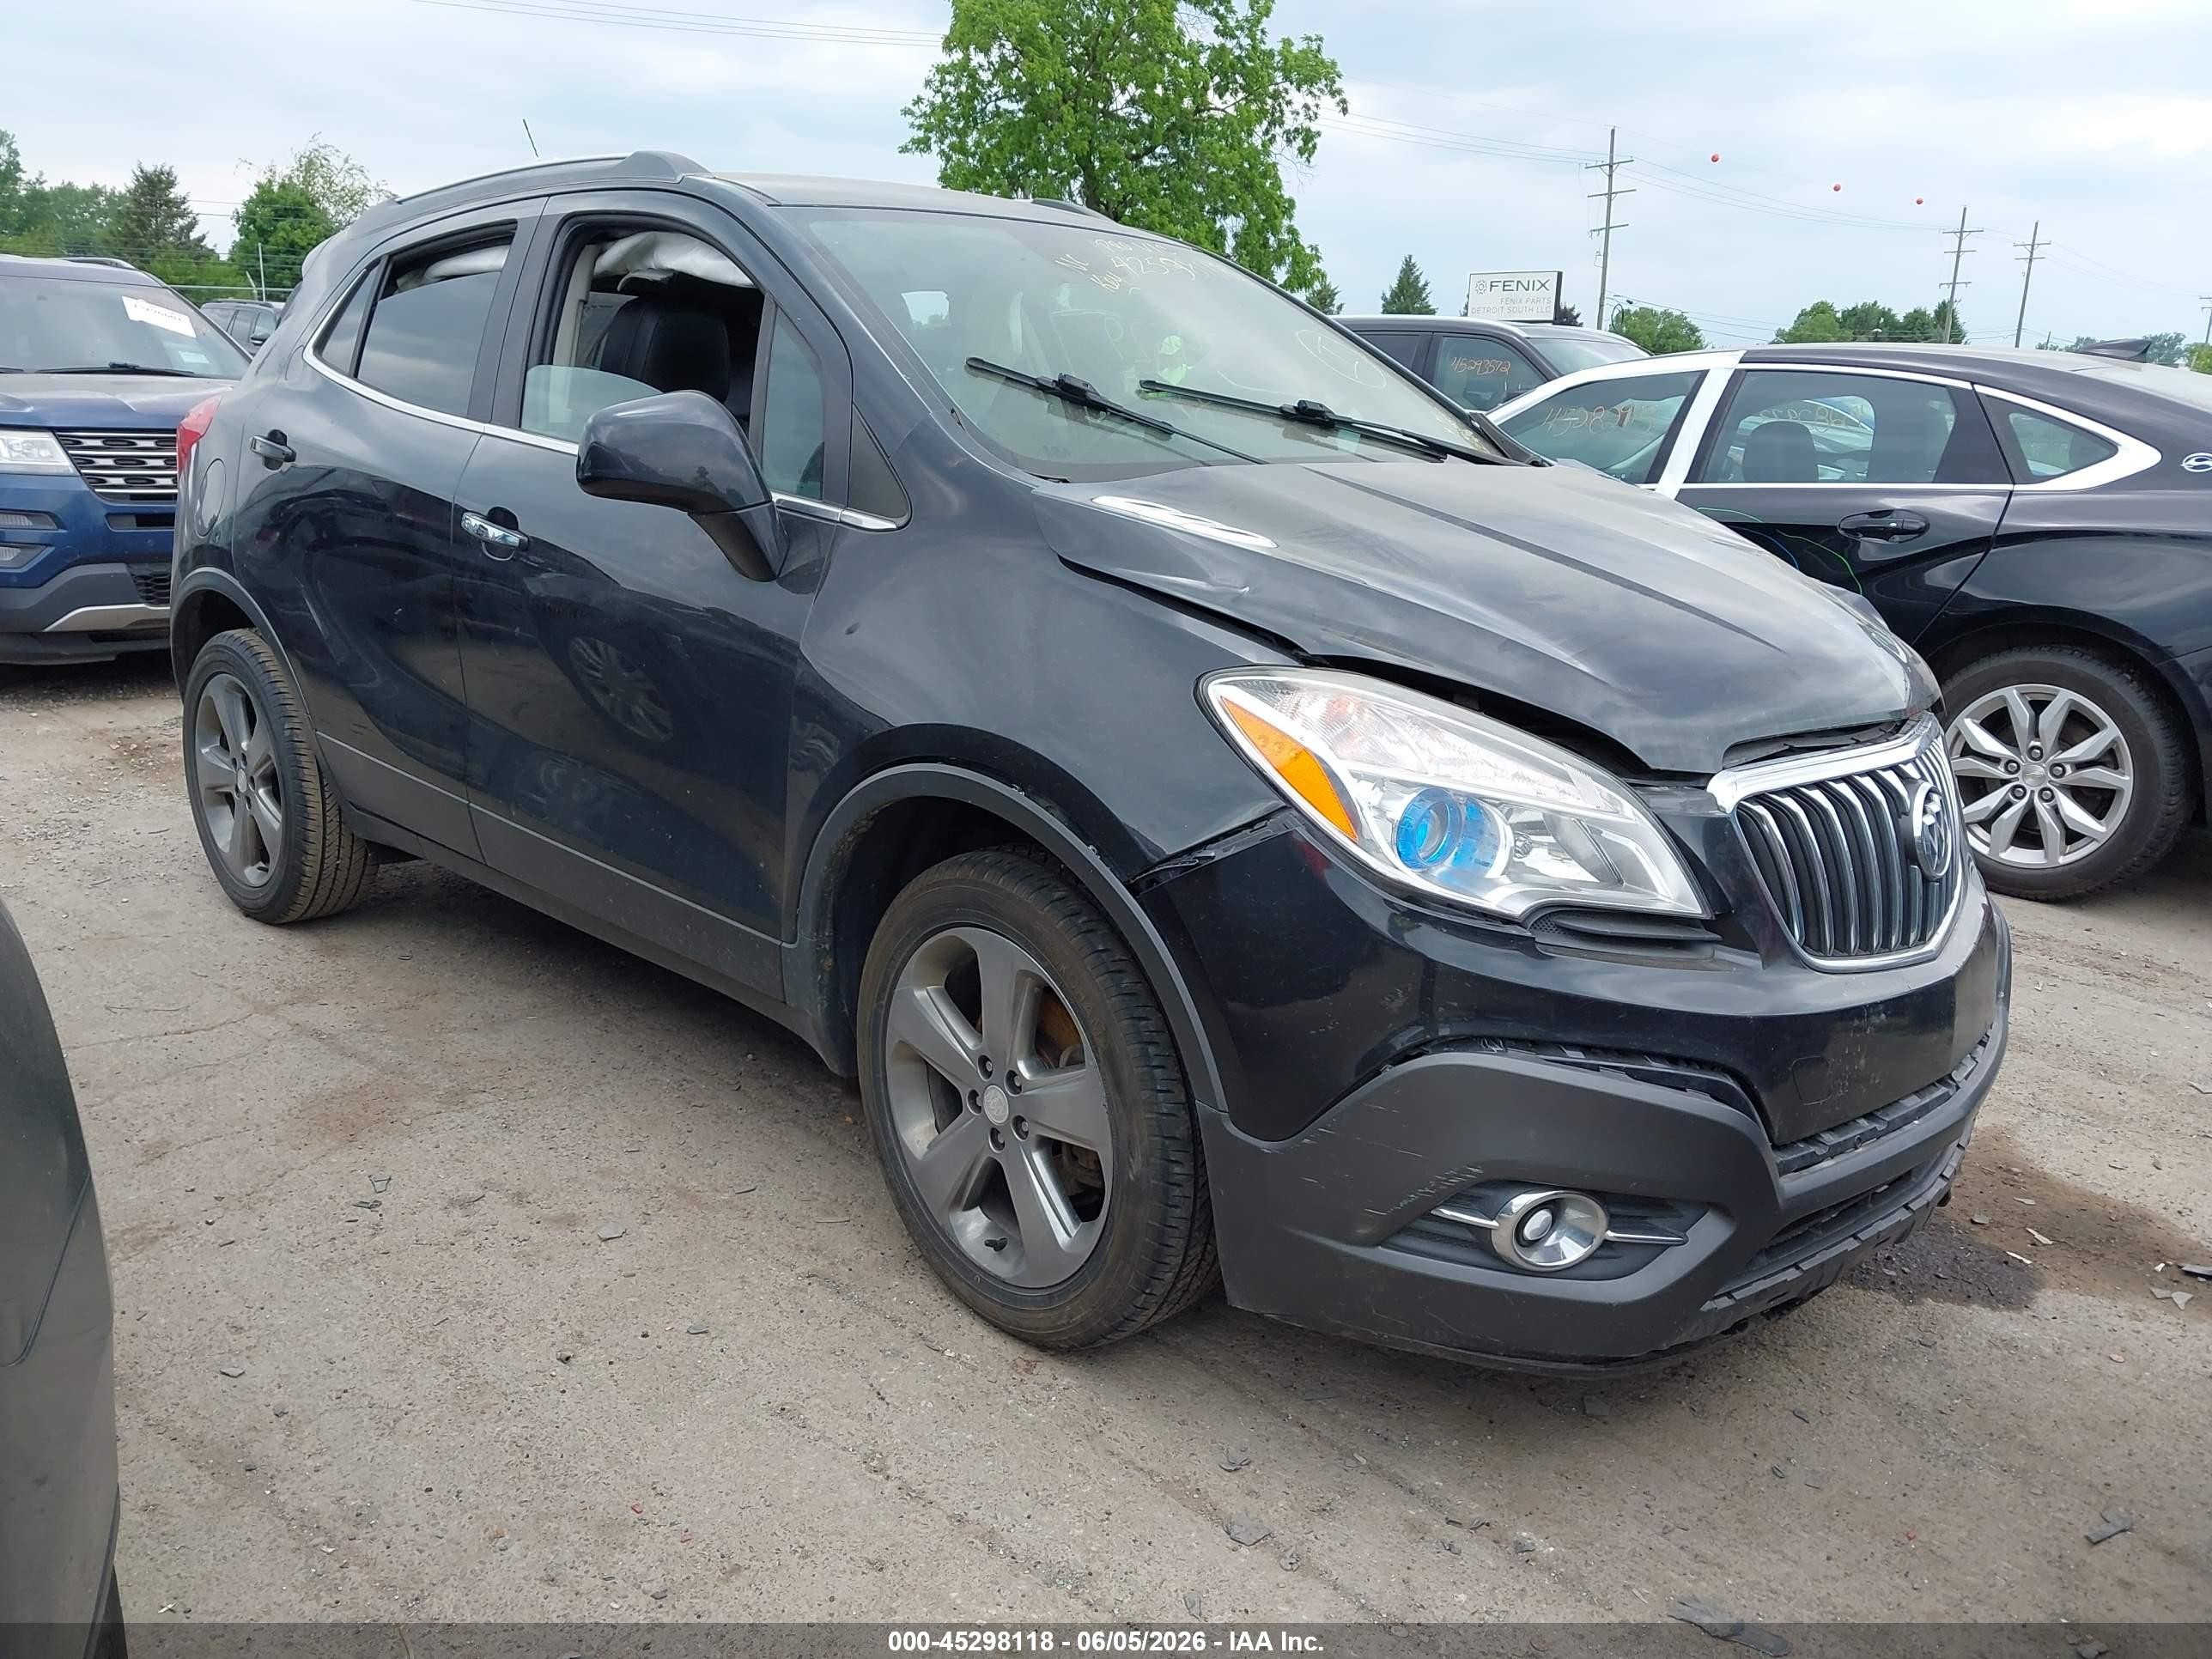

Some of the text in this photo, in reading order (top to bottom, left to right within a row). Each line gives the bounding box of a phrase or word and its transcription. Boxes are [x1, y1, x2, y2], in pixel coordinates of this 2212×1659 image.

[1489, 278, 1551, 293] FENIX
[1500, 296, 1553, 306] FENIX PARTS
[1471, 305, 1552, 315] DETROIT SOUTH LLC
